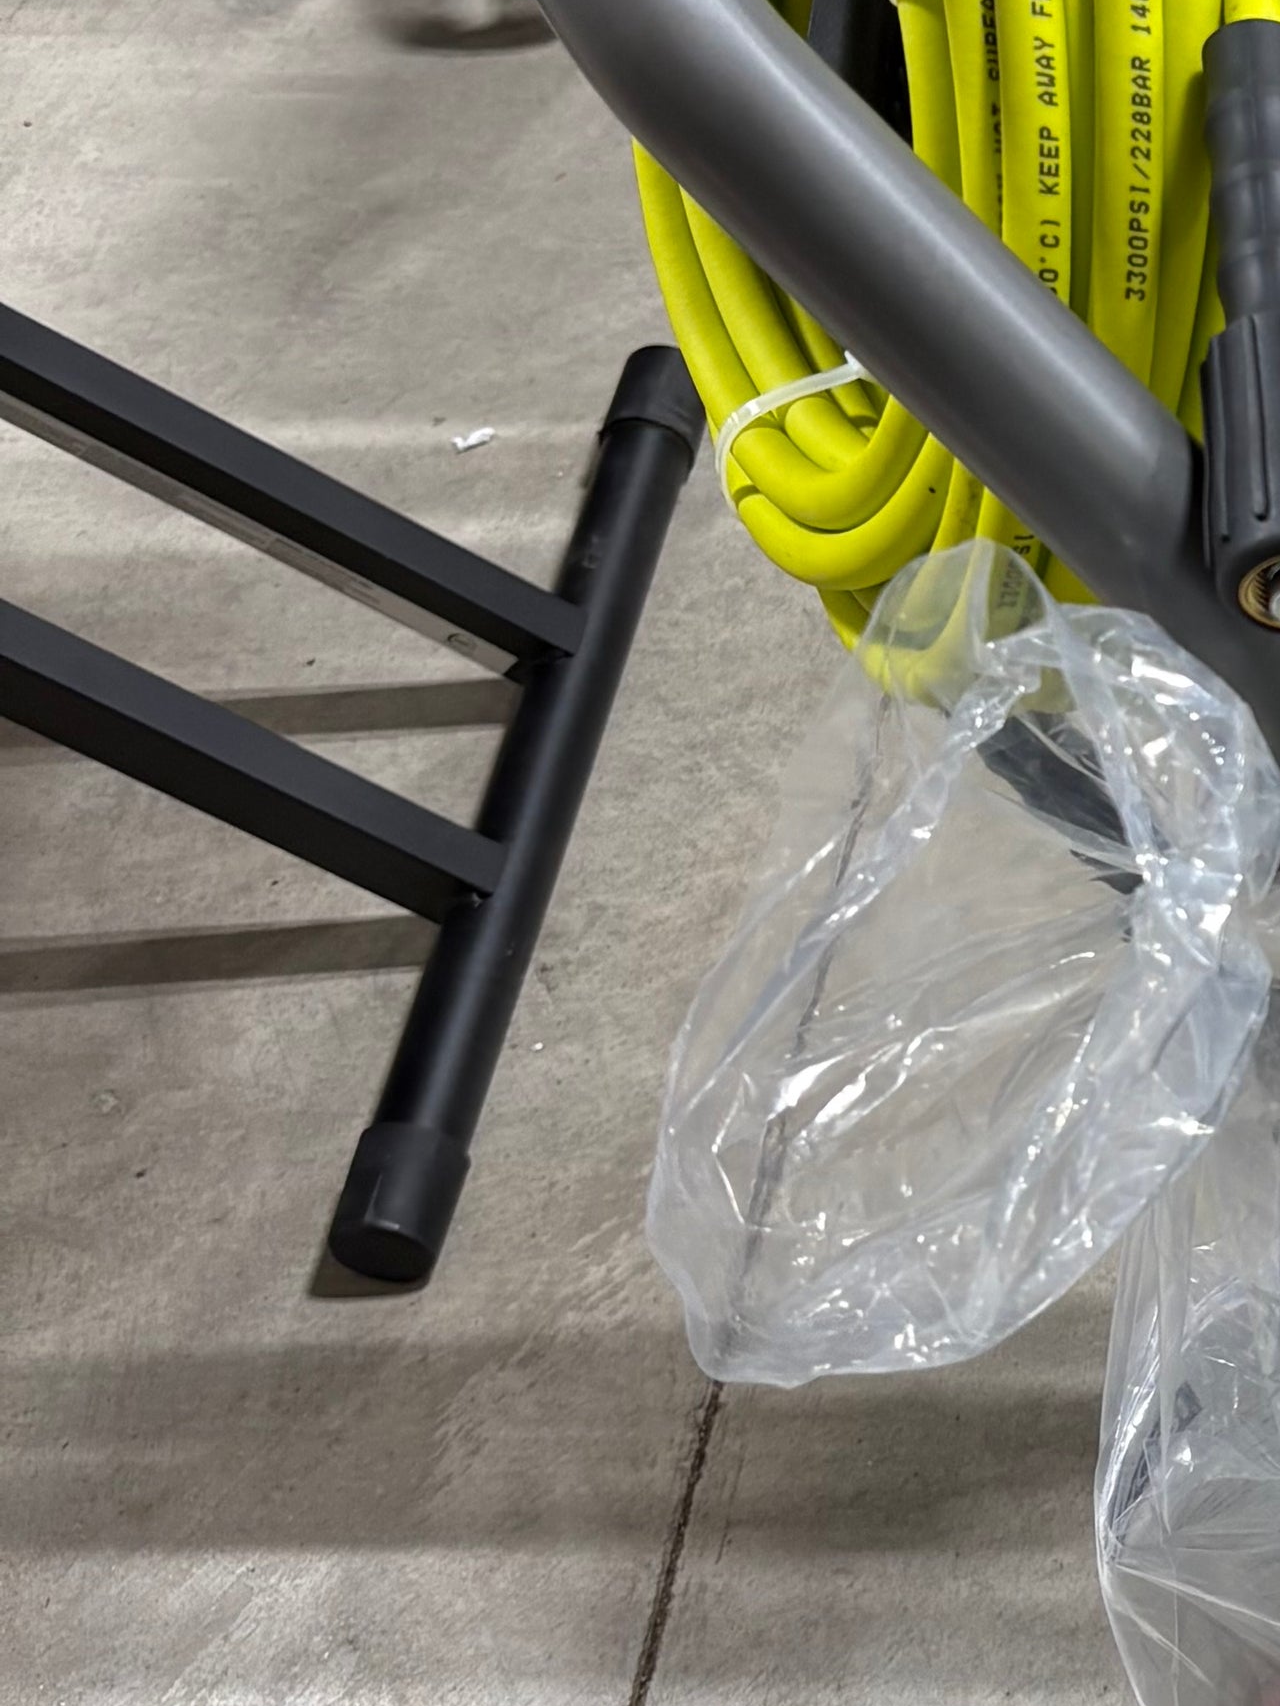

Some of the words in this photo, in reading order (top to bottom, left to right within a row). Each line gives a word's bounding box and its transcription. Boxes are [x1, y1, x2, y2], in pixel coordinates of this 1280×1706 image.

[1033, 36, 1059, 107] AWAY
[1039, 125, 1061, 196] KEEP
[1124, 55, 1153, 303] 3300PSI/228BAR
